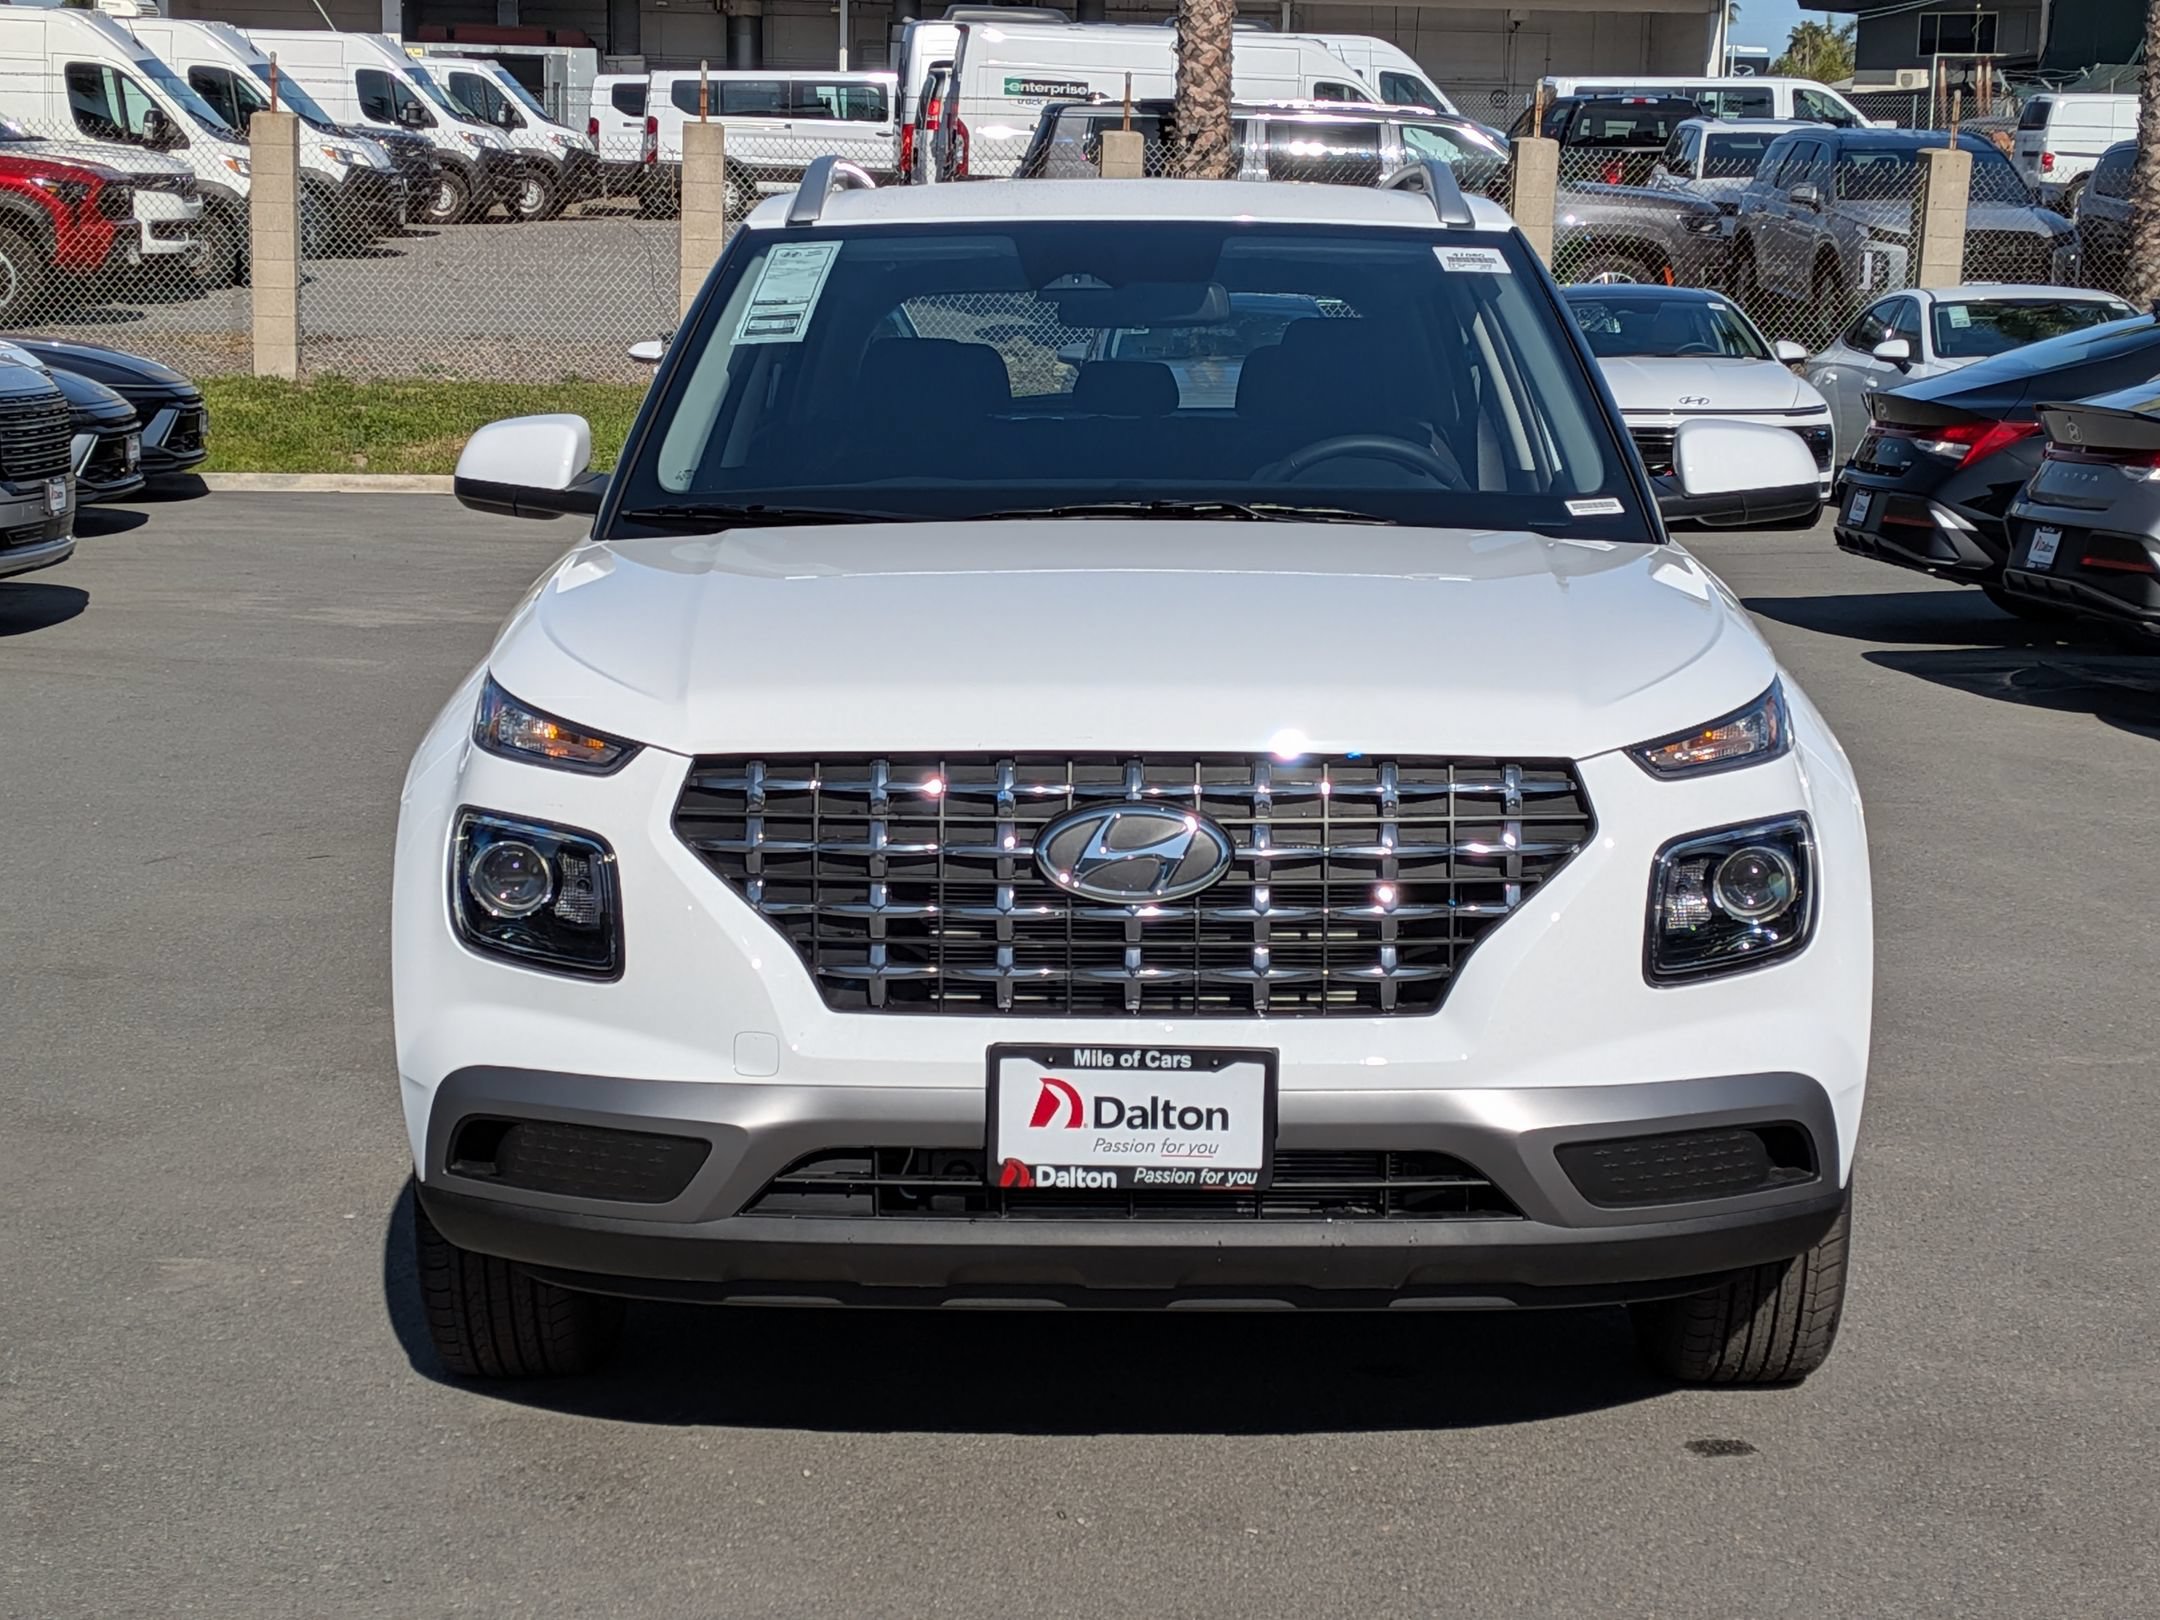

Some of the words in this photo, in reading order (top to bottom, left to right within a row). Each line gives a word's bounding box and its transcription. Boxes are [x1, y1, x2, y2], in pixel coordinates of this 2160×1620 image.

[1005, 82, 1087, 95] enterprise
[1074, 1049, 1114, 1067] Mile
[1120, 1050, 1141, 1067] of
[1145, 1050, 1192, 1068] Cars
[1093, 1096, 1229, 1131] Dalton
[1092, 1137, 1155, 1153] Passion
[1160, 1138, 1184, 1155] for
[1188, 1142, 1219, 1156] you
[1036, 1165, 1117, 1188] Dalton
[1134, 1167, 1195, 1184] Passion
[1200, 1168, 1224, 1184] for
[1226, 1171, 1258, 1187] you
